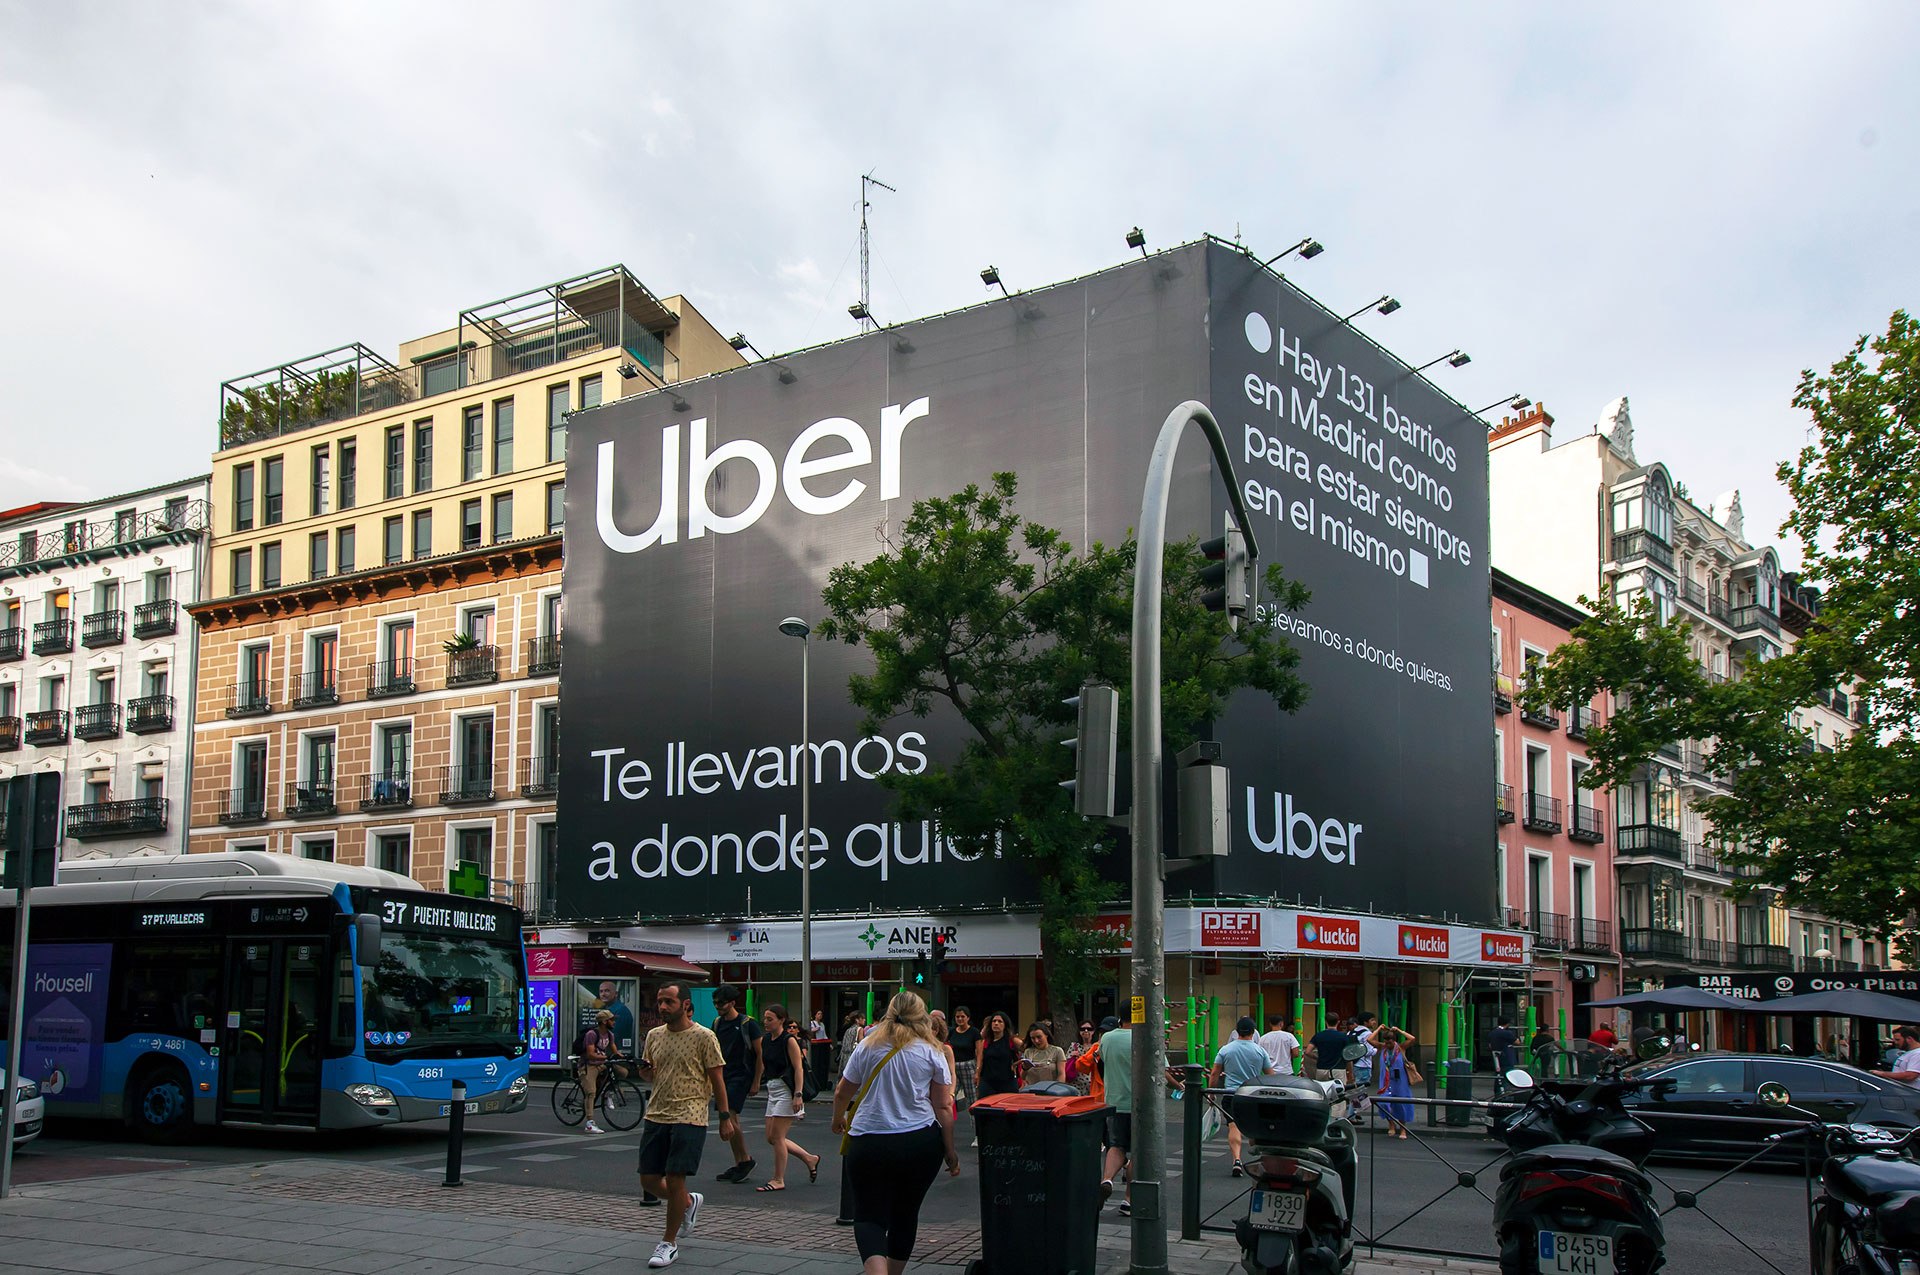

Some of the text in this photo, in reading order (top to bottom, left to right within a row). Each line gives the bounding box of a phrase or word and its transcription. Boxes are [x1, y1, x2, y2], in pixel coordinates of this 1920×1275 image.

[1279, 327, 1457, 473] Hay 131 barrios
[1244, 373, 1452, 512] en Madrid como
[596, 396, 929, 554] Uber
[1244, 423, 1471, 566] para estar siempre
[1244, 479, 1406, 576] en el mismo
[1270, 603, 1341, 649] llevamos
[1344, 636, 1354, 655] a
[1356, 639, 1404, 673] donde
[1406, 661, 1453, 692] quieras.
[591, 731, 927, 801] Te llevamos
[1246, 786, 1363, 866] Uber
[588, 840, 618, 881] a
[631, 814, 829, 878] donde
[142, 914, 153, 925] 37
[382, 901, 496, 931] 37 PUENTE VALLECAS
[1204, 914, 1257, 930] DEFI
[749, 931, 770, 944] LIA
[1319, 926, 1357, 946] luckia
[1415, 934, 1447, 953] luckia
[1495, 941, 1521, 958] luckia
[827, 965, 859, 975] luckia
[960, 963, 992, 973] luckia
[1699, 975, 1732, 987] BAR
[1810, 978, 1845, 991] Oro
[1863, 978, 1918, 991] Plata
[165, 1039, 186, 1050] 4861
[418, 1067, 444, 1079] 4861
[487, 1102, 498, 1110] SP
[1267, 1194, 1302, 1211] 1830
[1267, 1209, 1297, 1226] JZZ
[1557, 1236, 1609, 1257] 8459
[1557, 1254, 1597, 1275] LKH
